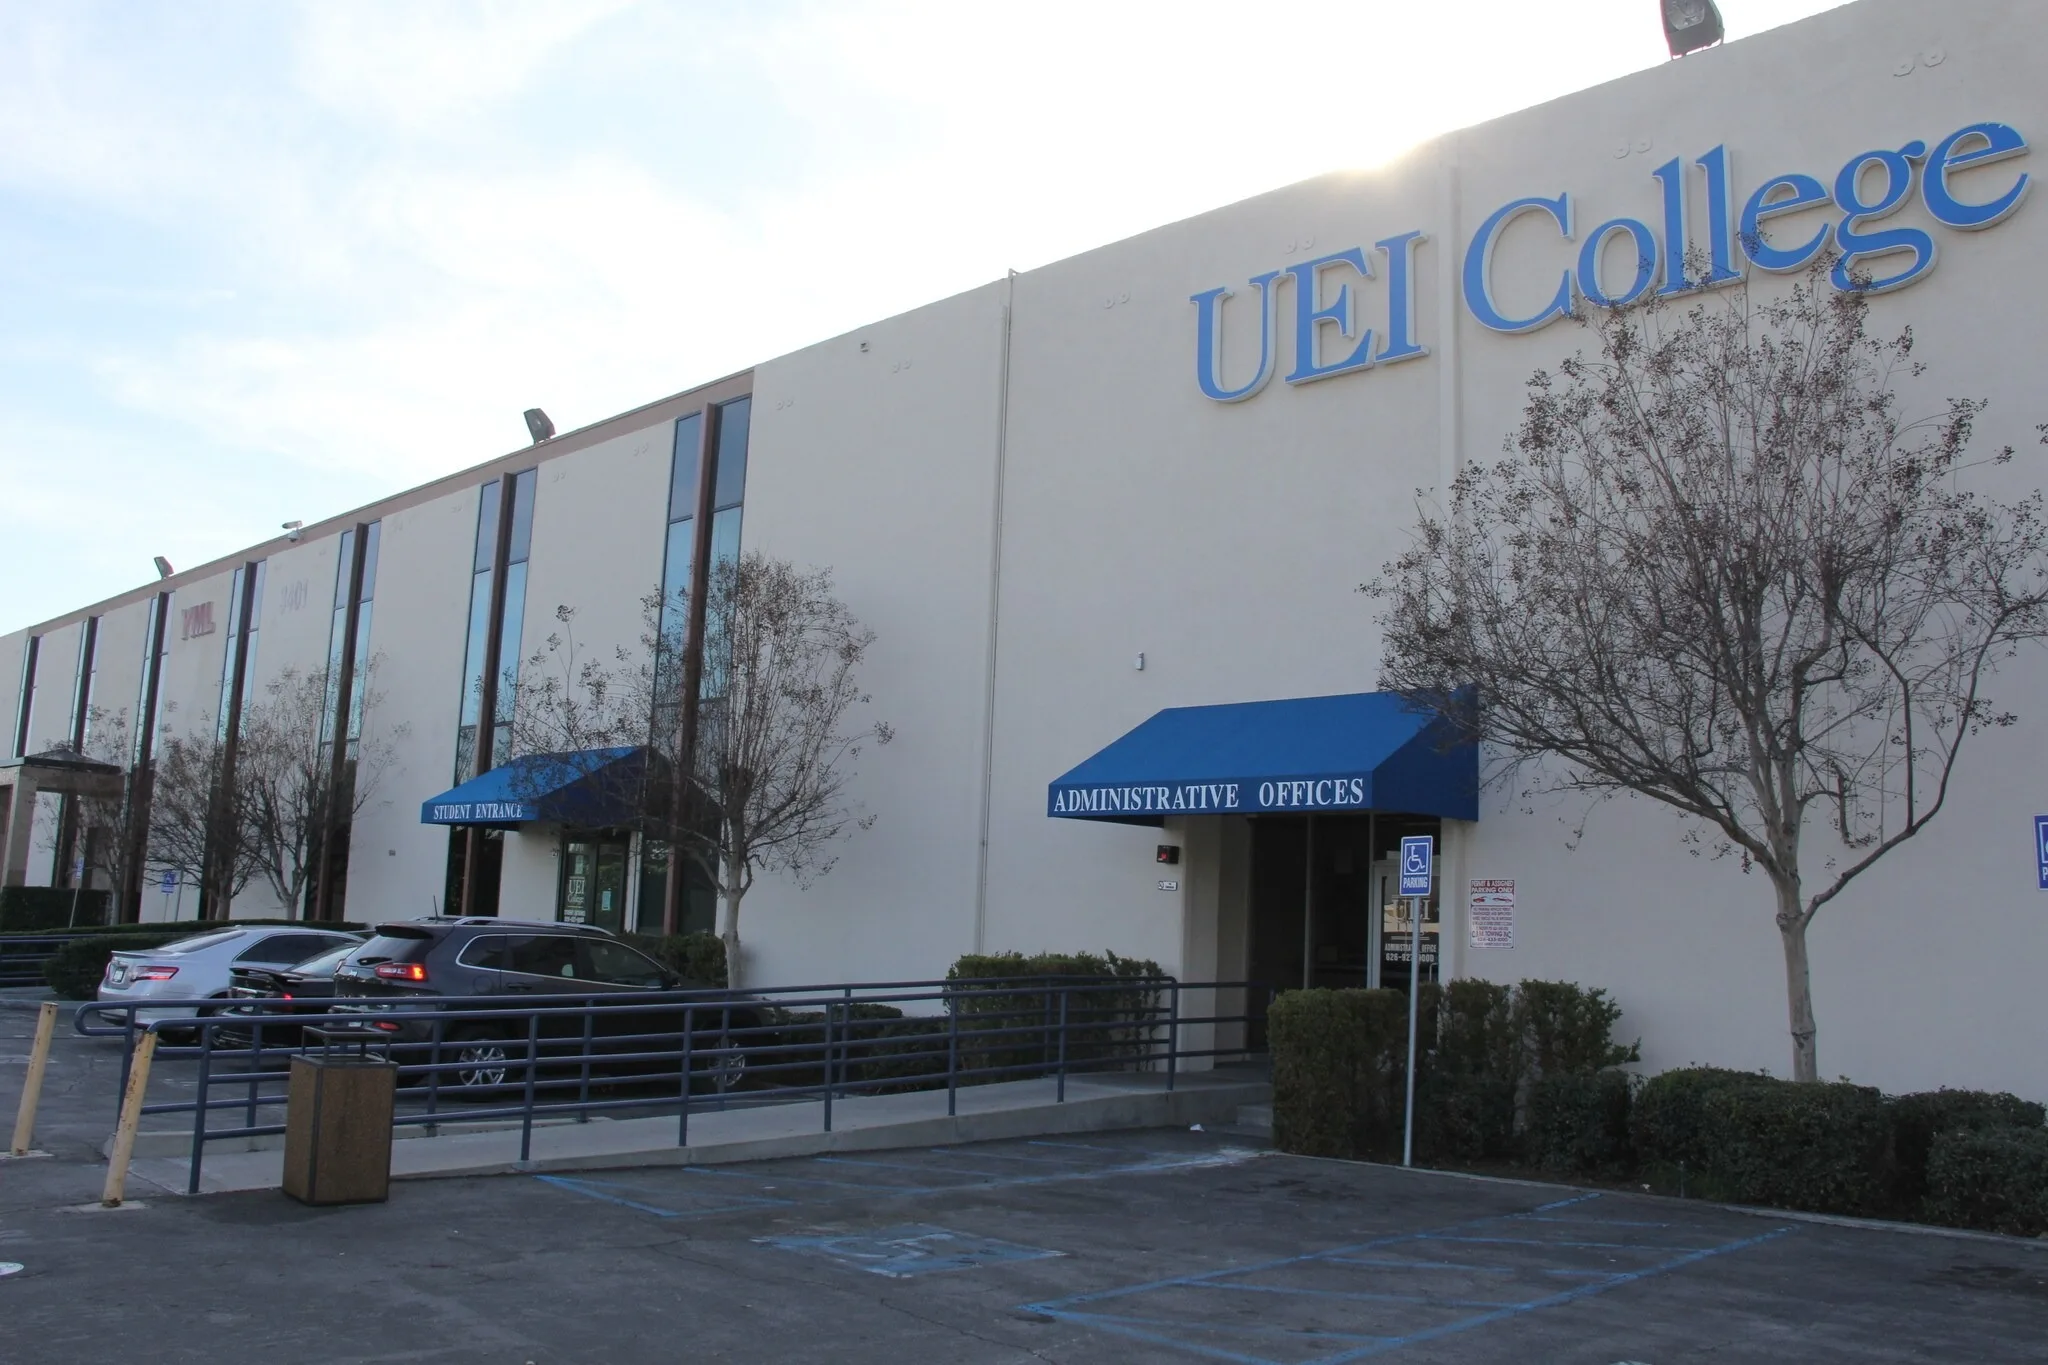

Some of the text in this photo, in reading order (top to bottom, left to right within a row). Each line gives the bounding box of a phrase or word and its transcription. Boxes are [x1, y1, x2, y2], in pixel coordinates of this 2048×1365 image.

[1189, 121, 2029, 402] UEI College
[1054, 778, 1364, 812] ADMINISTRATIVE OFFICES
[433, 802, 523, 820] STUDENT ENTRANCE
[568, 879, 585, 894] UEI
[1403, 877, 1428, 888] PARKING
